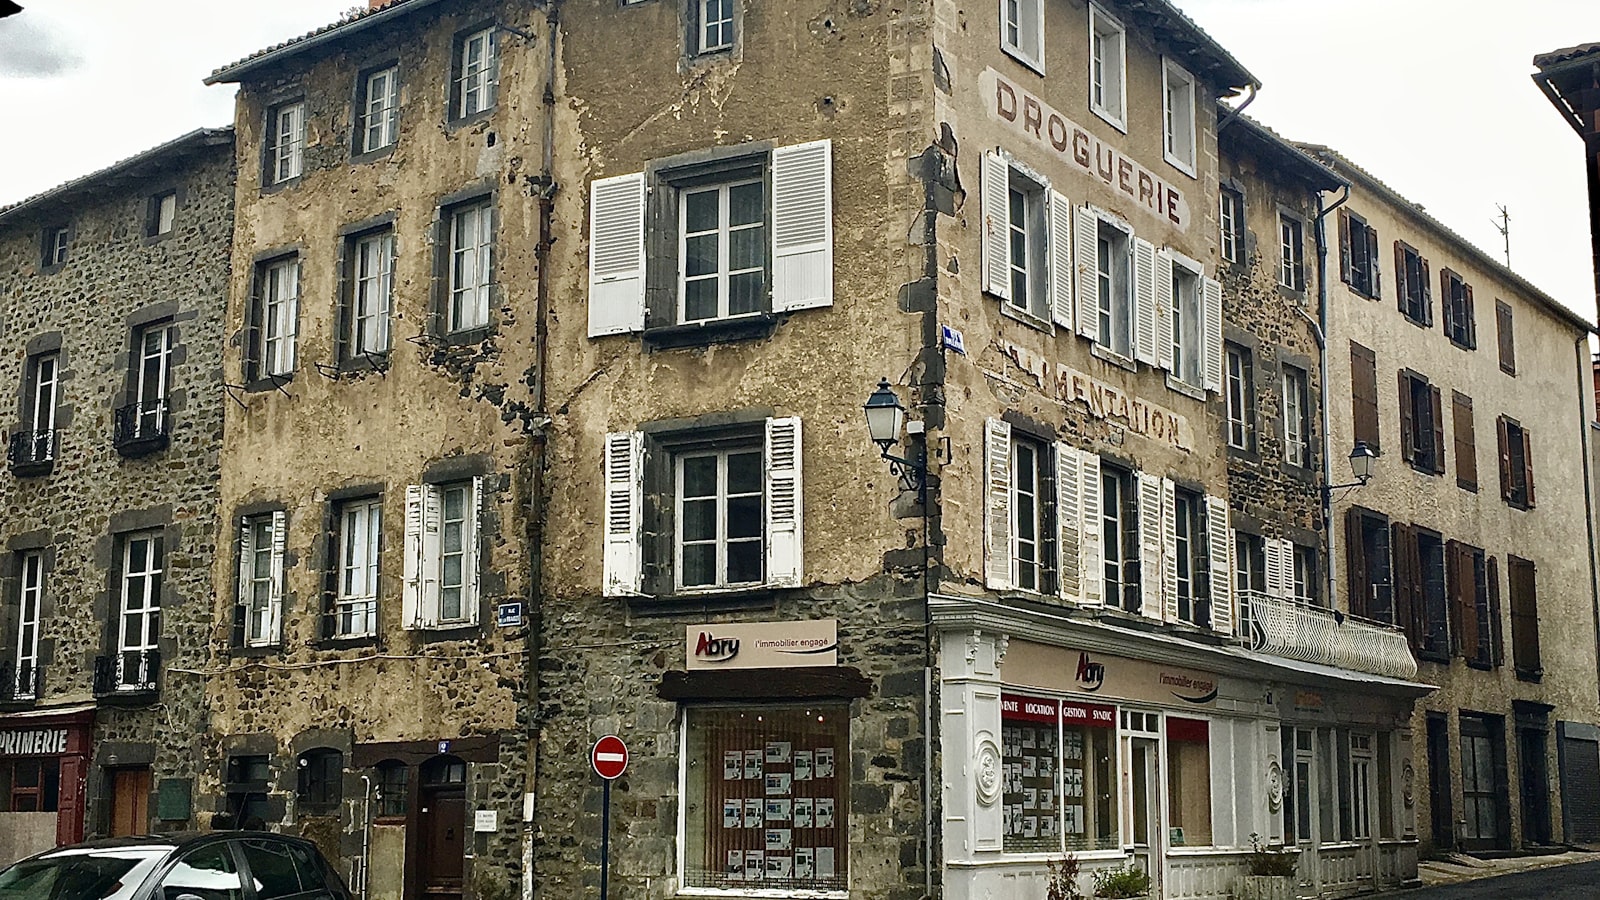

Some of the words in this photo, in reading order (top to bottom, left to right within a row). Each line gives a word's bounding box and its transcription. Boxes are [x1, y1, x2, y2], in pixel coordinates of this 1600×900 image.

[996, 78, 1180, 225] DROGUERIE
[695, 632, 740, 660] Abry
[755, 639, 799, 648] l'immobilier
[800, 638, 828, 647] engagé
[1025, 703, 1055, 716] LOCATION
[1063, 707, 1087, 718] GESTION
[1093, 709, 1112, 721] SYNDIC
